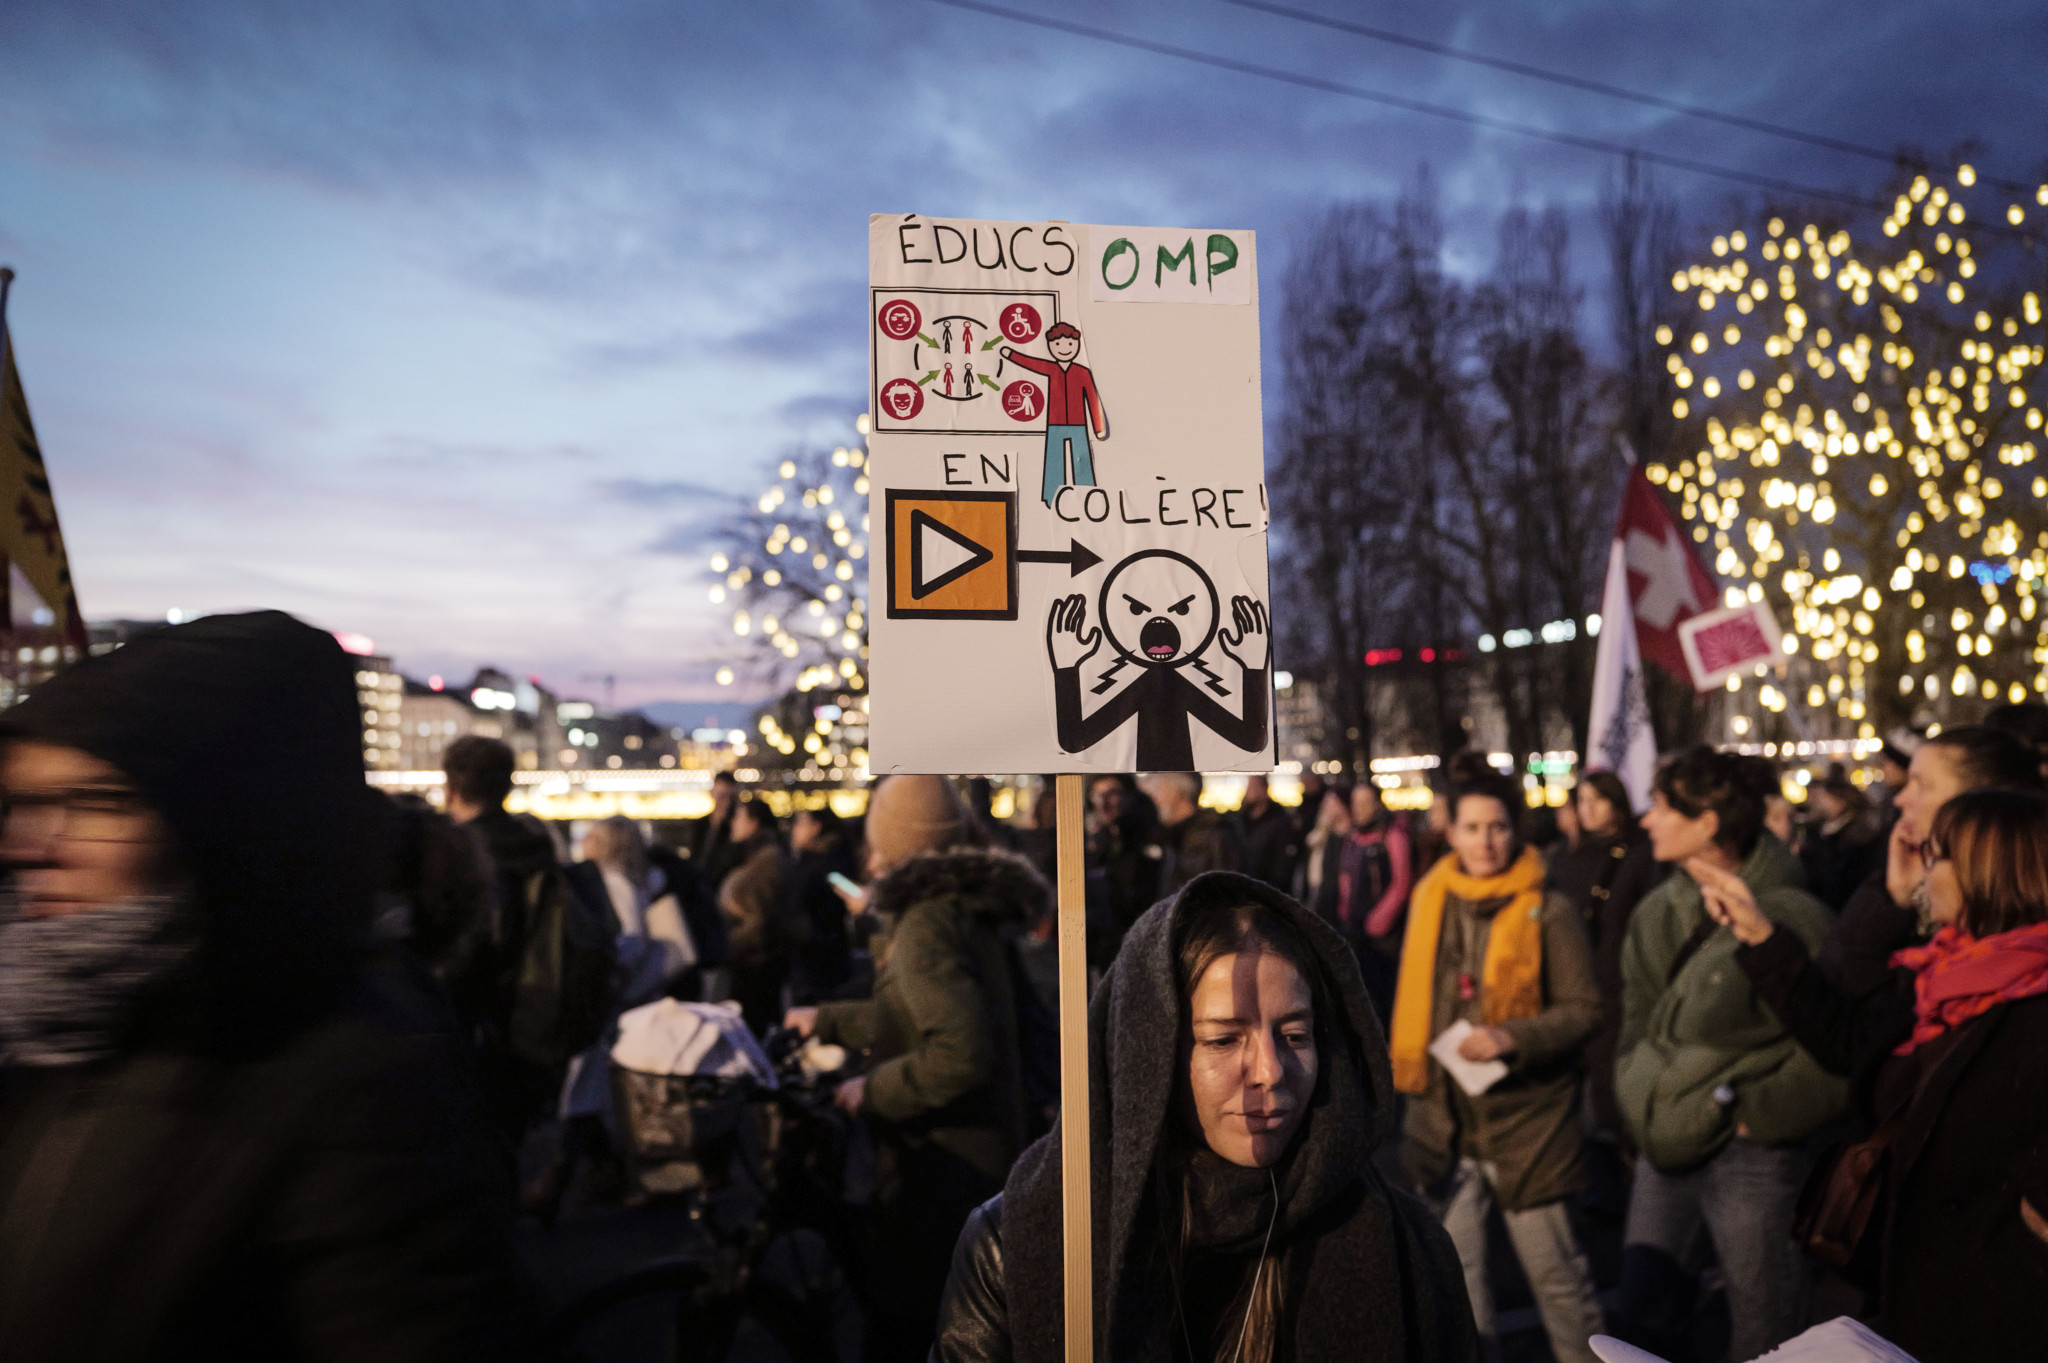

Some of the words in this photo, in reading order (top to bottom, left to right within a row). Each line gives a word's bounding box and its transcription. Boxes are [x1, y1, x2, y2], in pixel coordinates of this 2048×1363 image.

[899, 213, 1076, 276] ÉDUCS
[1101, 234, 1240, 294] OMP
[943, 454, 1010, 486] EN
[1054, 476, 1269, 529] COLÈRE!
